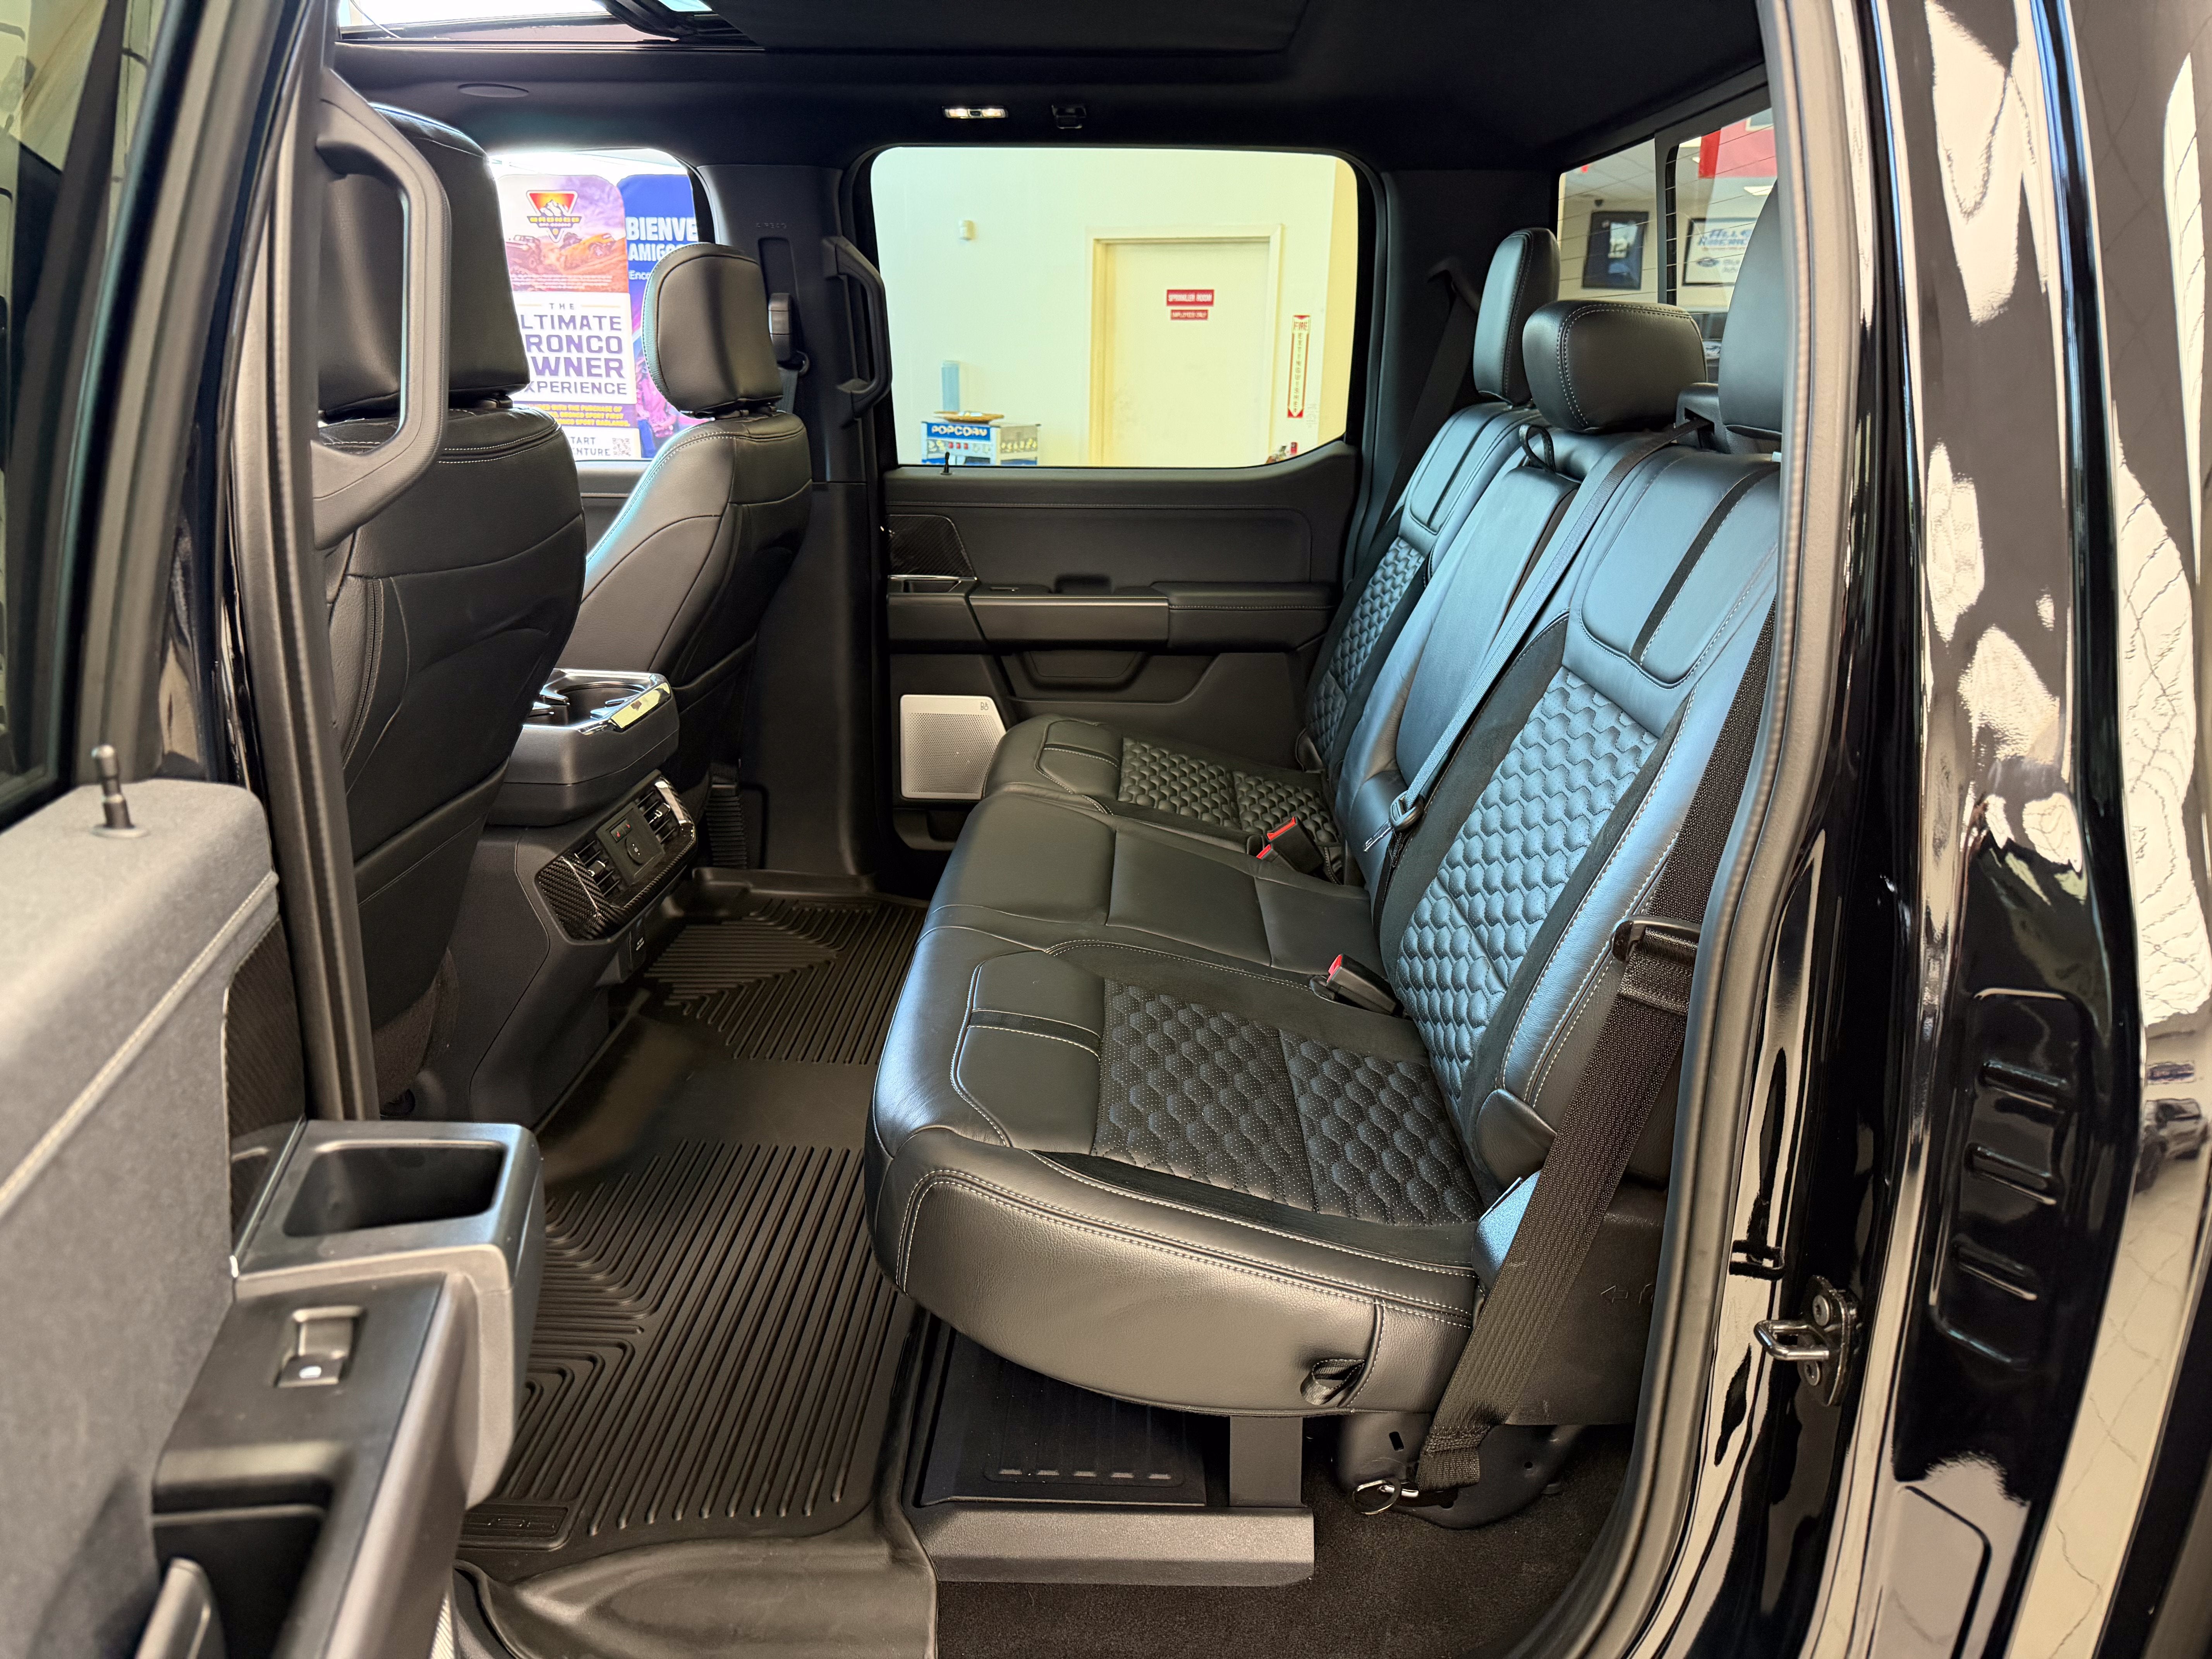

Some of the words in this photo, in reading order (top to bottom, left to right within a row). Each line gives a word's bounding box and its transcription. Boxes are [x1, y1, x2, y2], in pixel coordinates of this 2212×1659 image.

[625, 217, 699, 241] BIENVE
[628, 243, 684, 261] AMIGO
[520, 314, 622, 331] LTIMATE
[525, 334, 623, 354] RONCO
[531, 356, 625, 379] WNER
[524, 381, 627, 395] XPERIENCE
[931, 425, 988, 436] POPCORN
[570, 436, 596, 445] TART
[573, 448, 611, 456] NTURE
